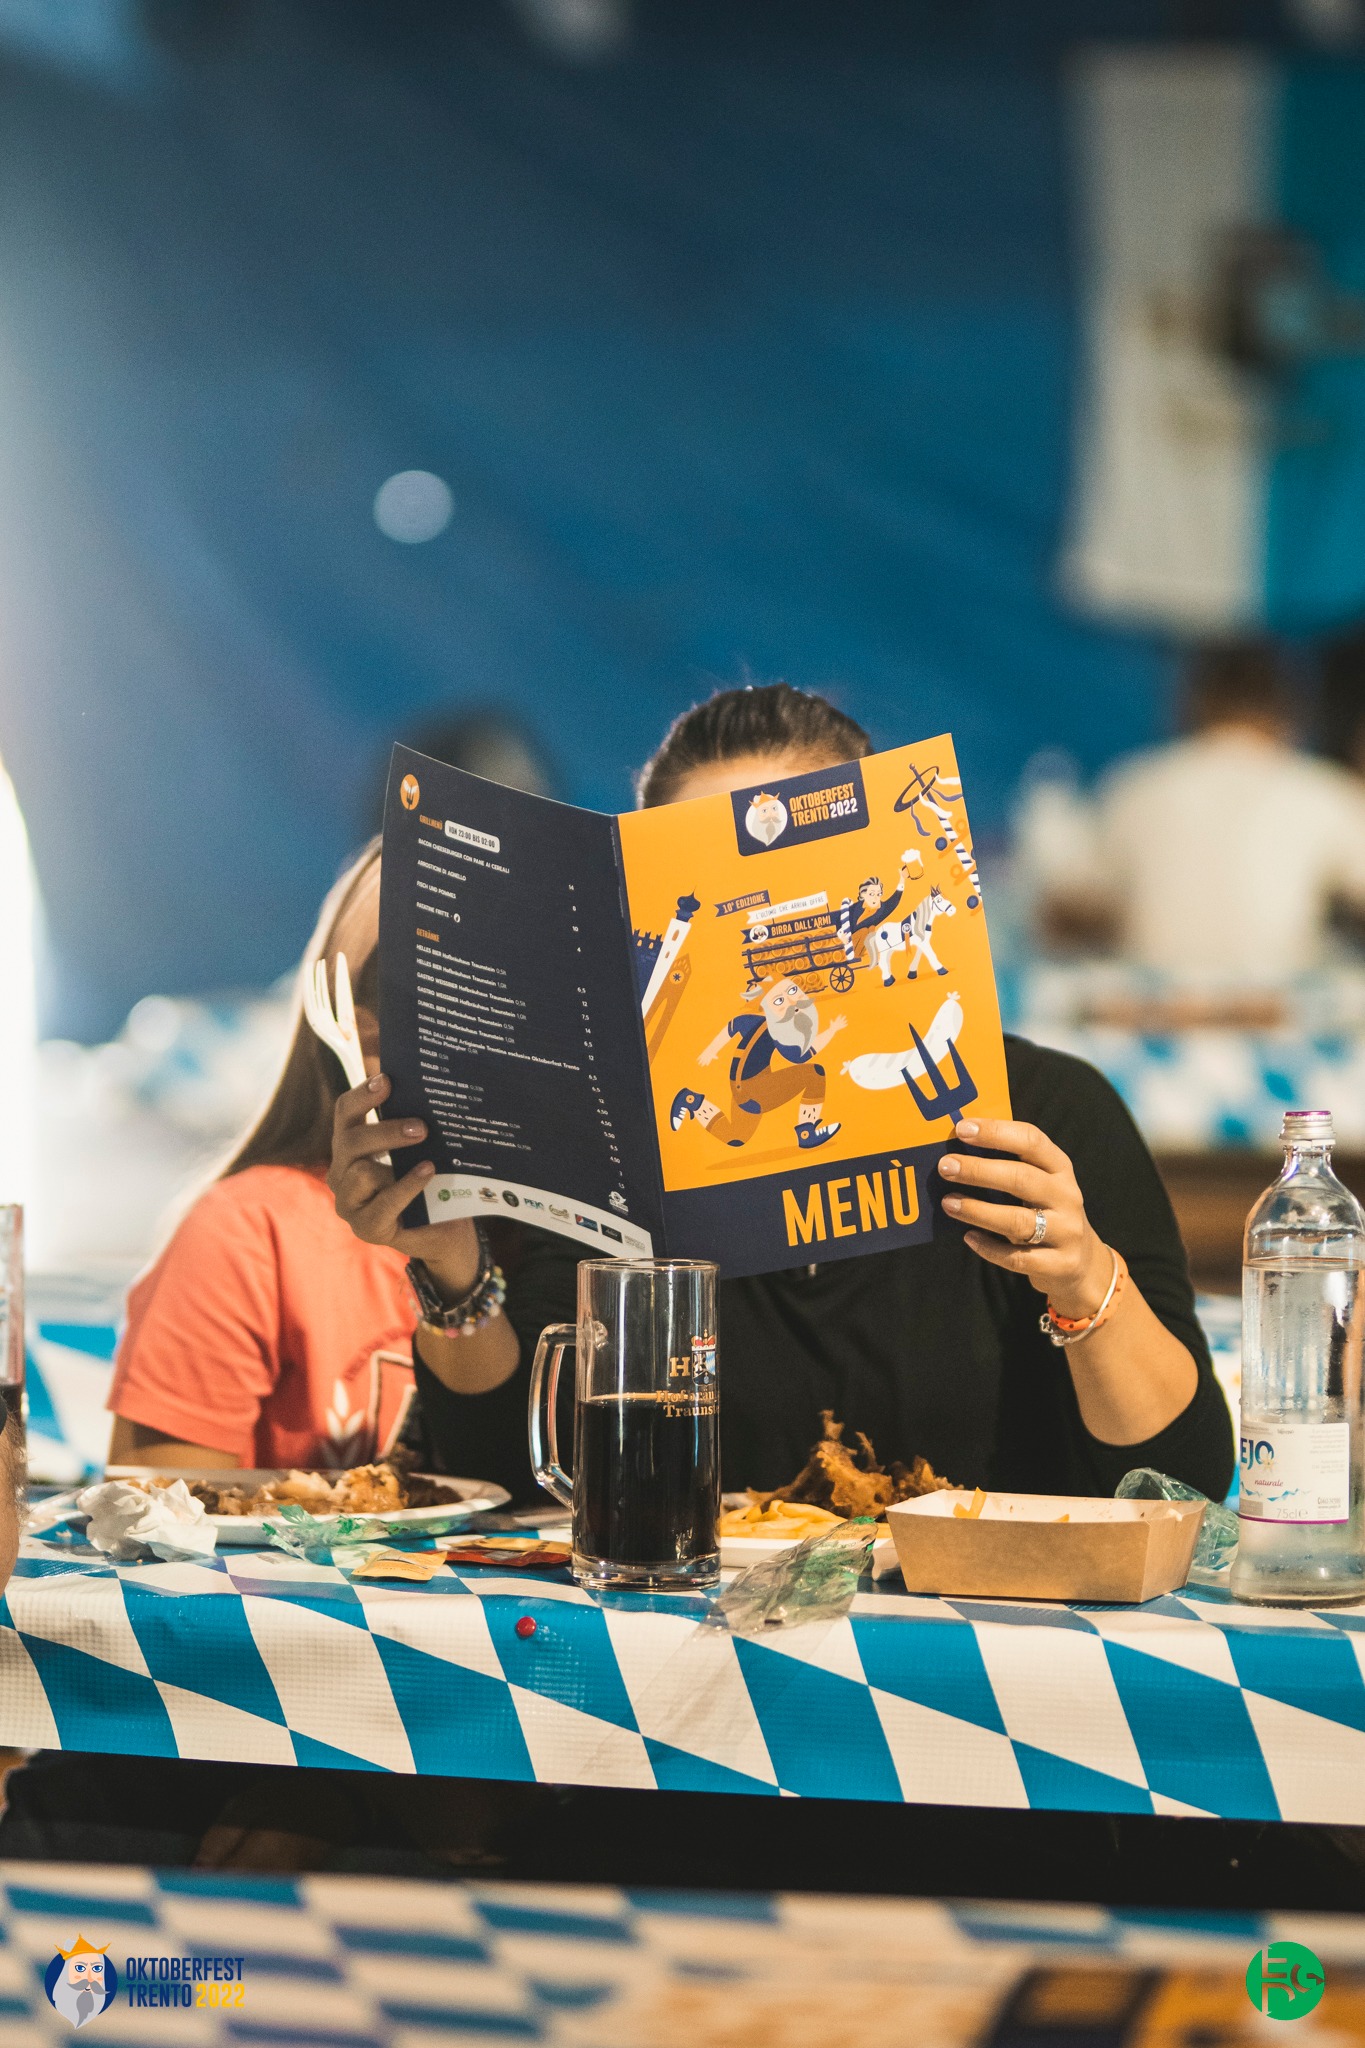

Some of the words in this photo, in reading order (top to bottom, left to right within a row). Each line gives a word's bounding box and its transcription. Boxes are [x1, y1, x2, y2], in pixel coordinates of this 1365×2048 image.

[789, 782, 854, 812] OKTOBERFEST
[791, 804, 830, 827] TRENTO
[829, 797, 858, 819] 2022
[458, 829, 471, 840] 23:00
[472, 834, 481, 843] BIS
[481, 836, 495, 848] 02:00
[418, 837, 432, 848] BACON
[463, 854, 473, 862] CON
[473, 857, 485, 867] PANE
[491, 863, 510, 874] CEREALI
[438, 888, 457, 899] POMMES
[735, 893, 766, 909] EDIZIONE
[771, 925, 792, 936] BIRRA
[794, 915, 831, 932] DALL'ARMI
[416, 943, 432, 954] HELLES
[431, 948, 442, 957] BIER
[416, 957, 432, 968] HELLES
[432, 962, 442, 971] BIER
[416, 971, 435, 982] GASTRO
[416, 985, 435, 996] GASTRO
[417, 999, 435, 1010] DUNKEL
[435, 1005, 446, 1013] BIER
[418, 1013, 436, 1024] DUNKEL
[531, 1055, 562, 1067] Oktoberfest
[562, 1062, 580, 1071] Trento
[782, 1159, 920, 1247] MENÙ
[670, 1357, 690, 1377] H
[1254, 1479, 1284, 1487] naturale
